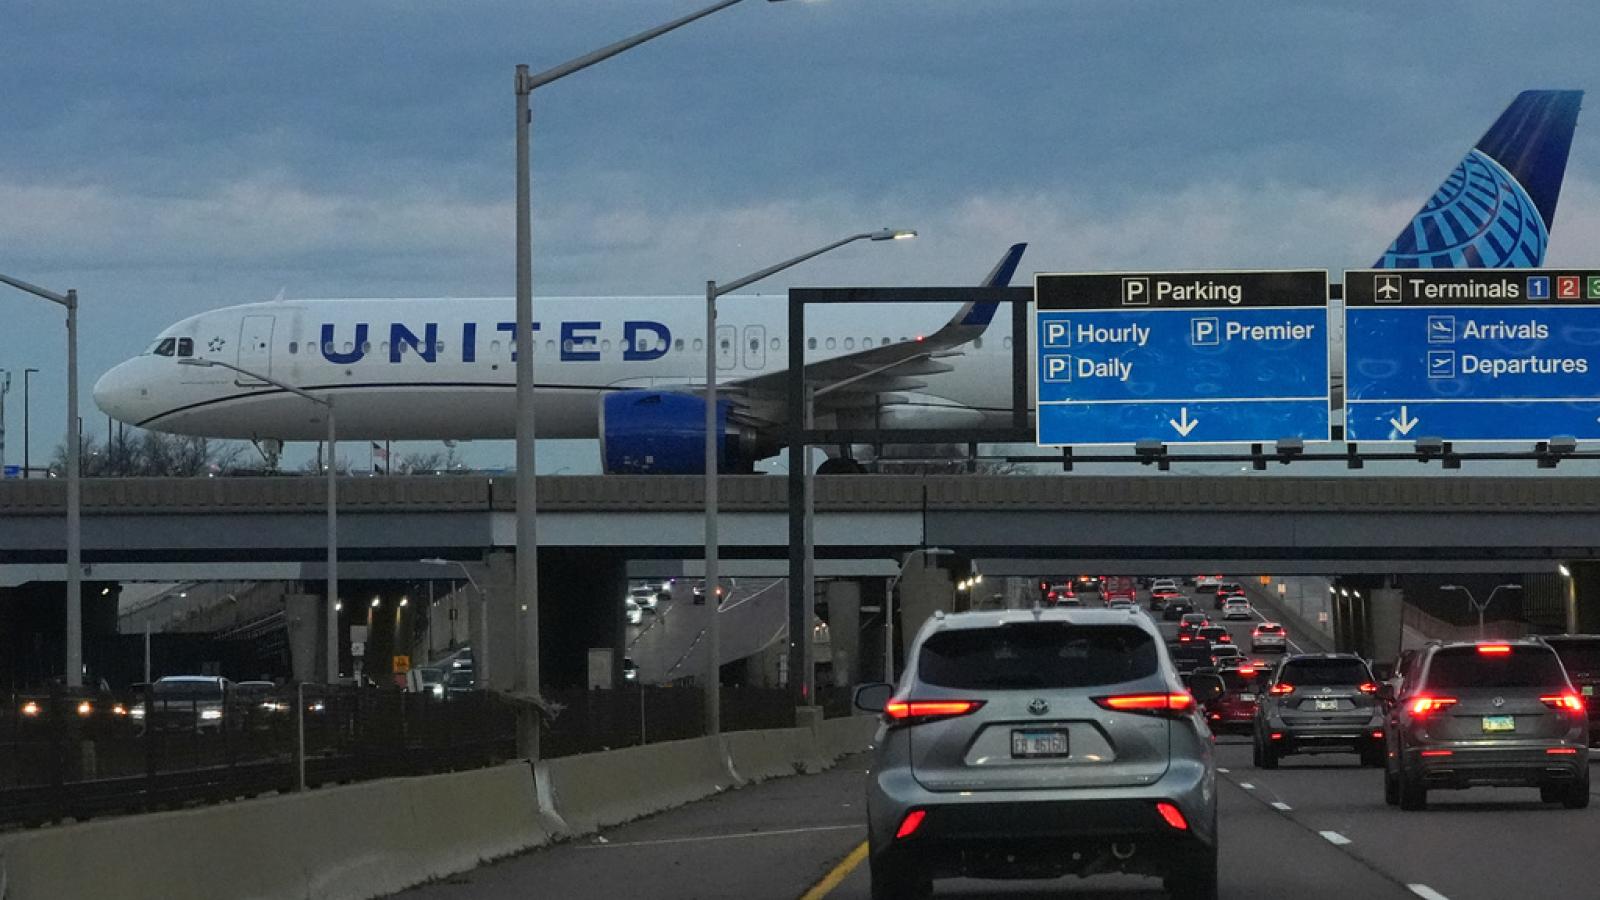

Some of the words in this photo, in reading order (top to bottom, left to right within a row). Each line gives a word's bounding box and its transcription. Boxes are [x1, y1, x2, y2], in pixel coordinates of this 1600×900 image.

[1127, 282, 1144, 300] P
[1157, 281, 1242, 303] Parking
[1409, 279, 1520, 298] Terminals
[1533, 280, 1542, 295] 1
[1563, 280, 1575, 296] 2
[1048, 324, 1065, 343] P
[1077, 323, 1150, 346] Hourly
[1196, 322, 1213, 341] P
[1226, 321, 1314, 341] Premier
[1463, 320, 1549, 339] Arrivals
[320, 321, 672, 364] UNITED
[1049, 359, 1065, 378] P
[1078, 358, 1133, 382] Daily
[1462, 355, 1588, 378] Departures
